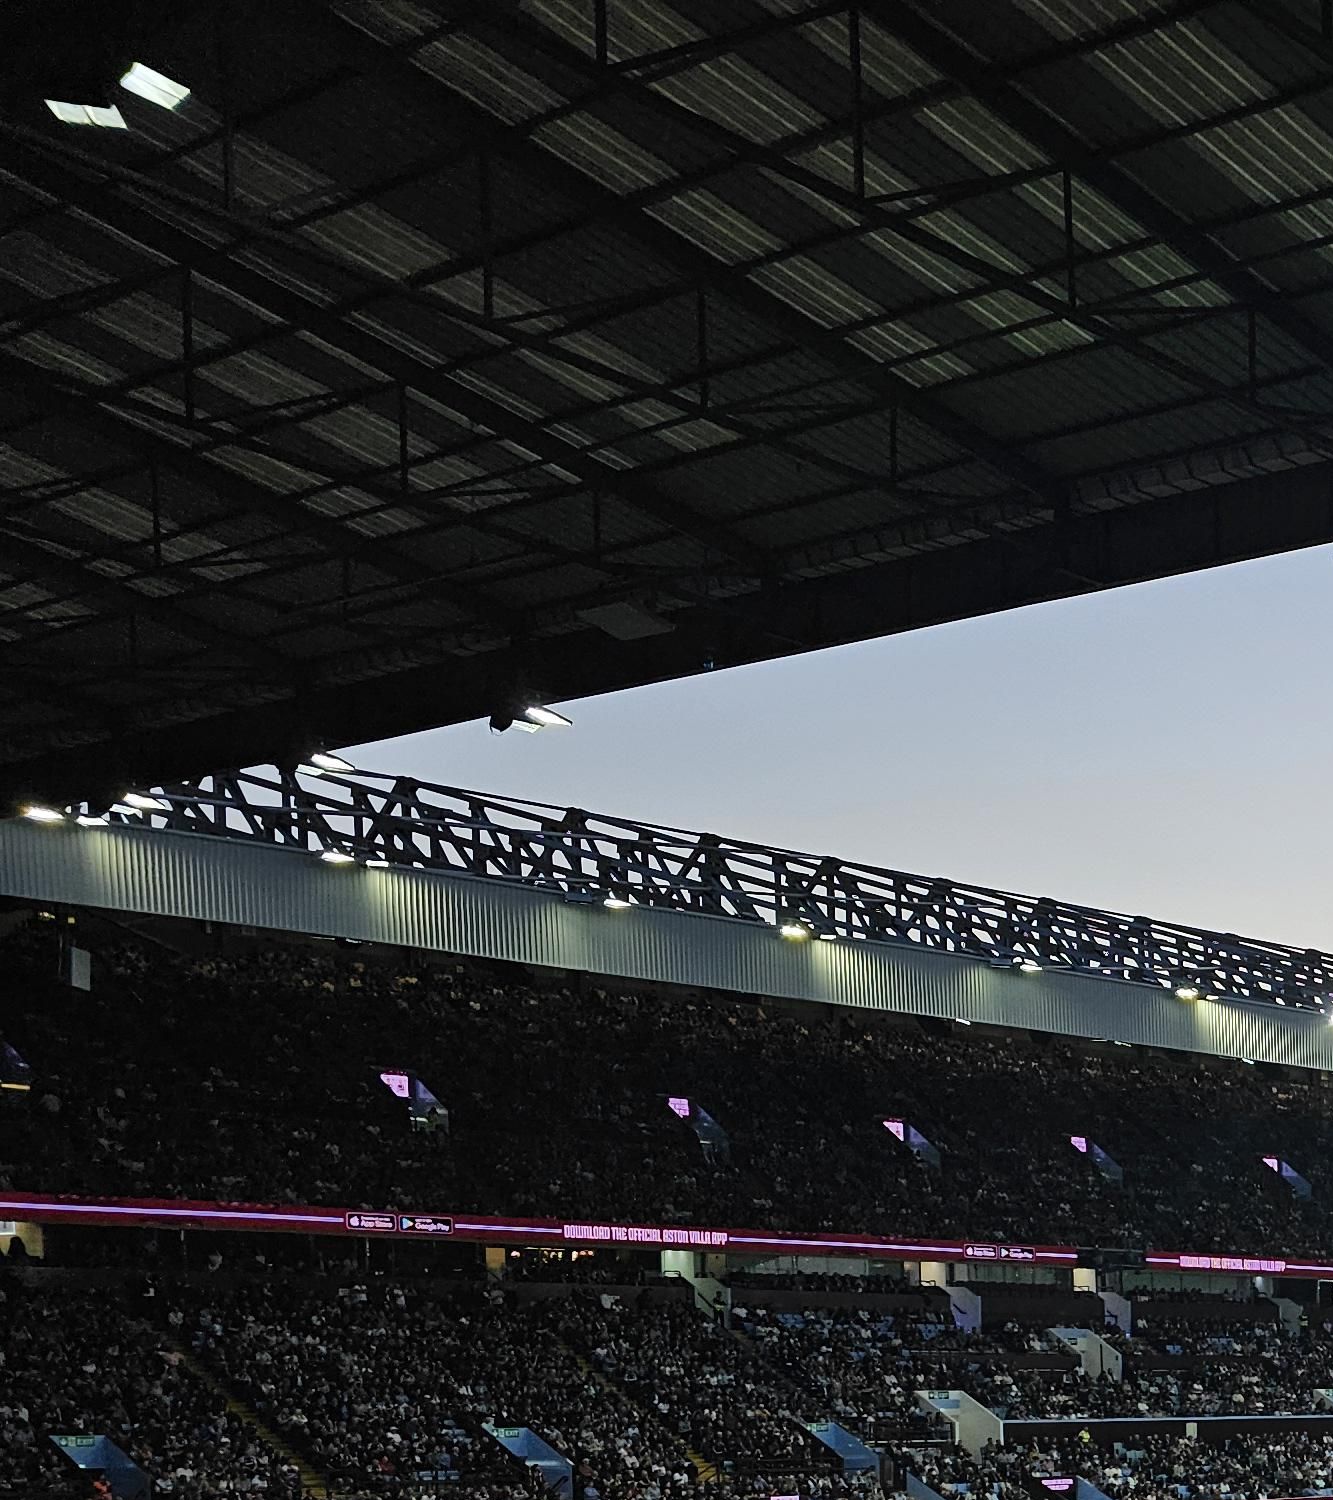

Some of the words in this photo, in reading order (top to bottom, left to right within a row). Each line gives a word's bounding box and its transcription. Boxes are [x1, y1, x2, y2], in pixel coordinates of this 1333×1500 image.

[564, 1225, 610, 1239] DOWNLOAD
[611, 1227, 627, 1240] THE
[628, 1228, 662, 1242] OFFICIAL
[663, 1229, 688, 1243] ASTON
[690, 1231, 711, 1244] VILLA
[712, 1232, 728, 1245] APP
